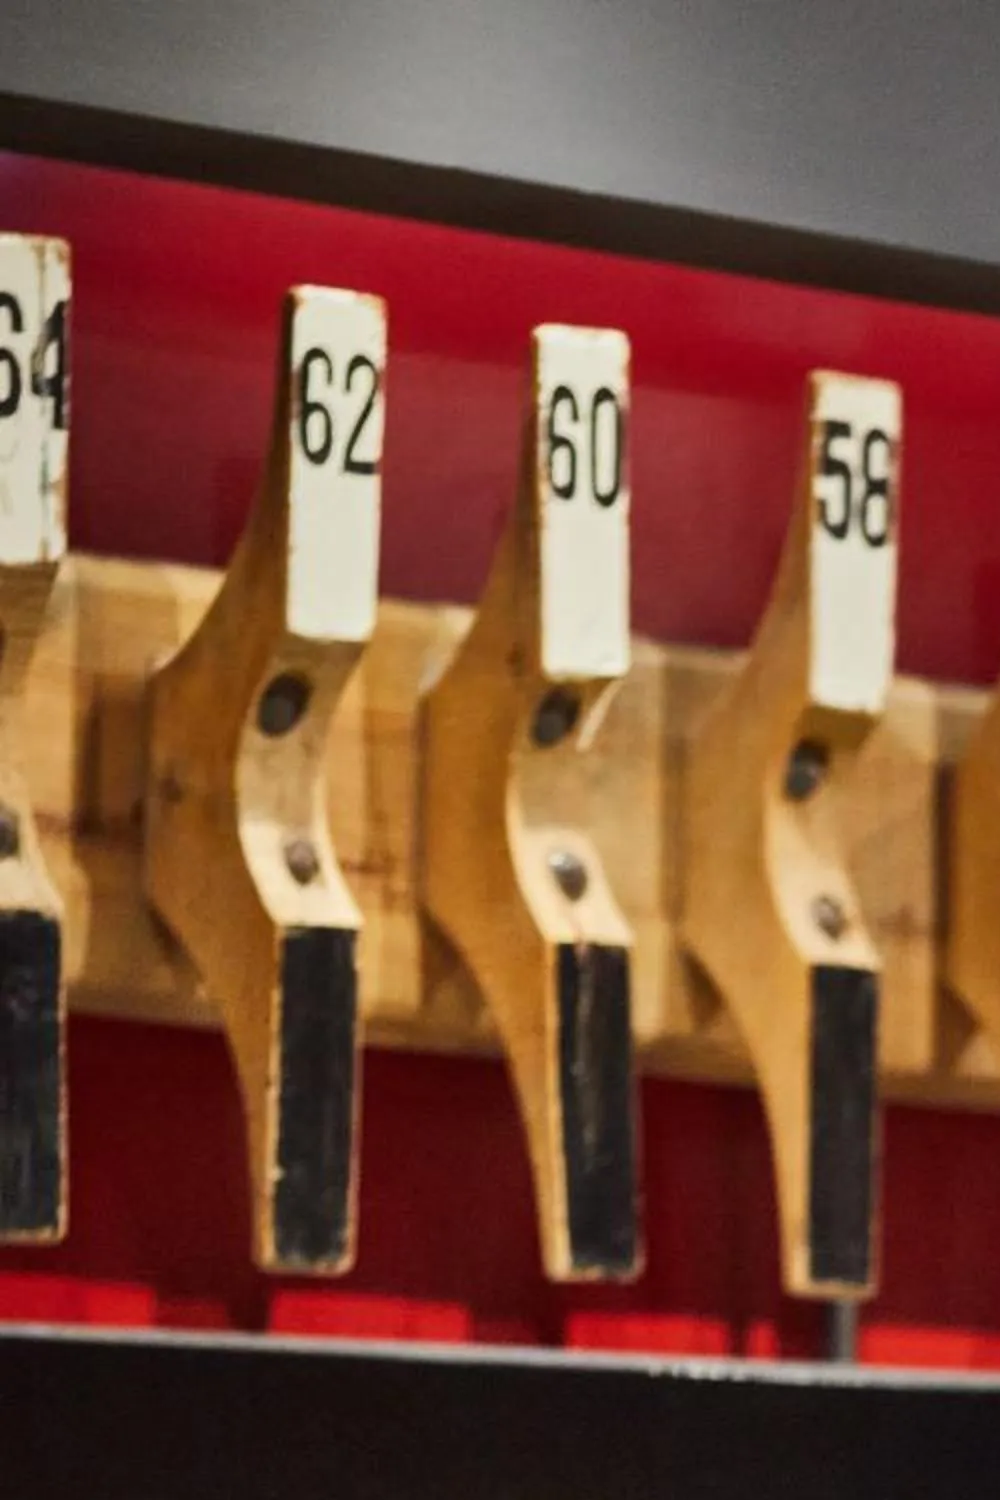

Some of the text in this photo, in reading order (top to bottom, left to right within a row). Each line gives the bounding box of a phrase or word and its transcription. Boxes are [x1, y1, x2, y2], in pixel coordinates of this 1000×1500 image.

[299, 347, 382, 476] 62
[545, 386, 626, 508] 60
[816, 419, 894, 548] 58
